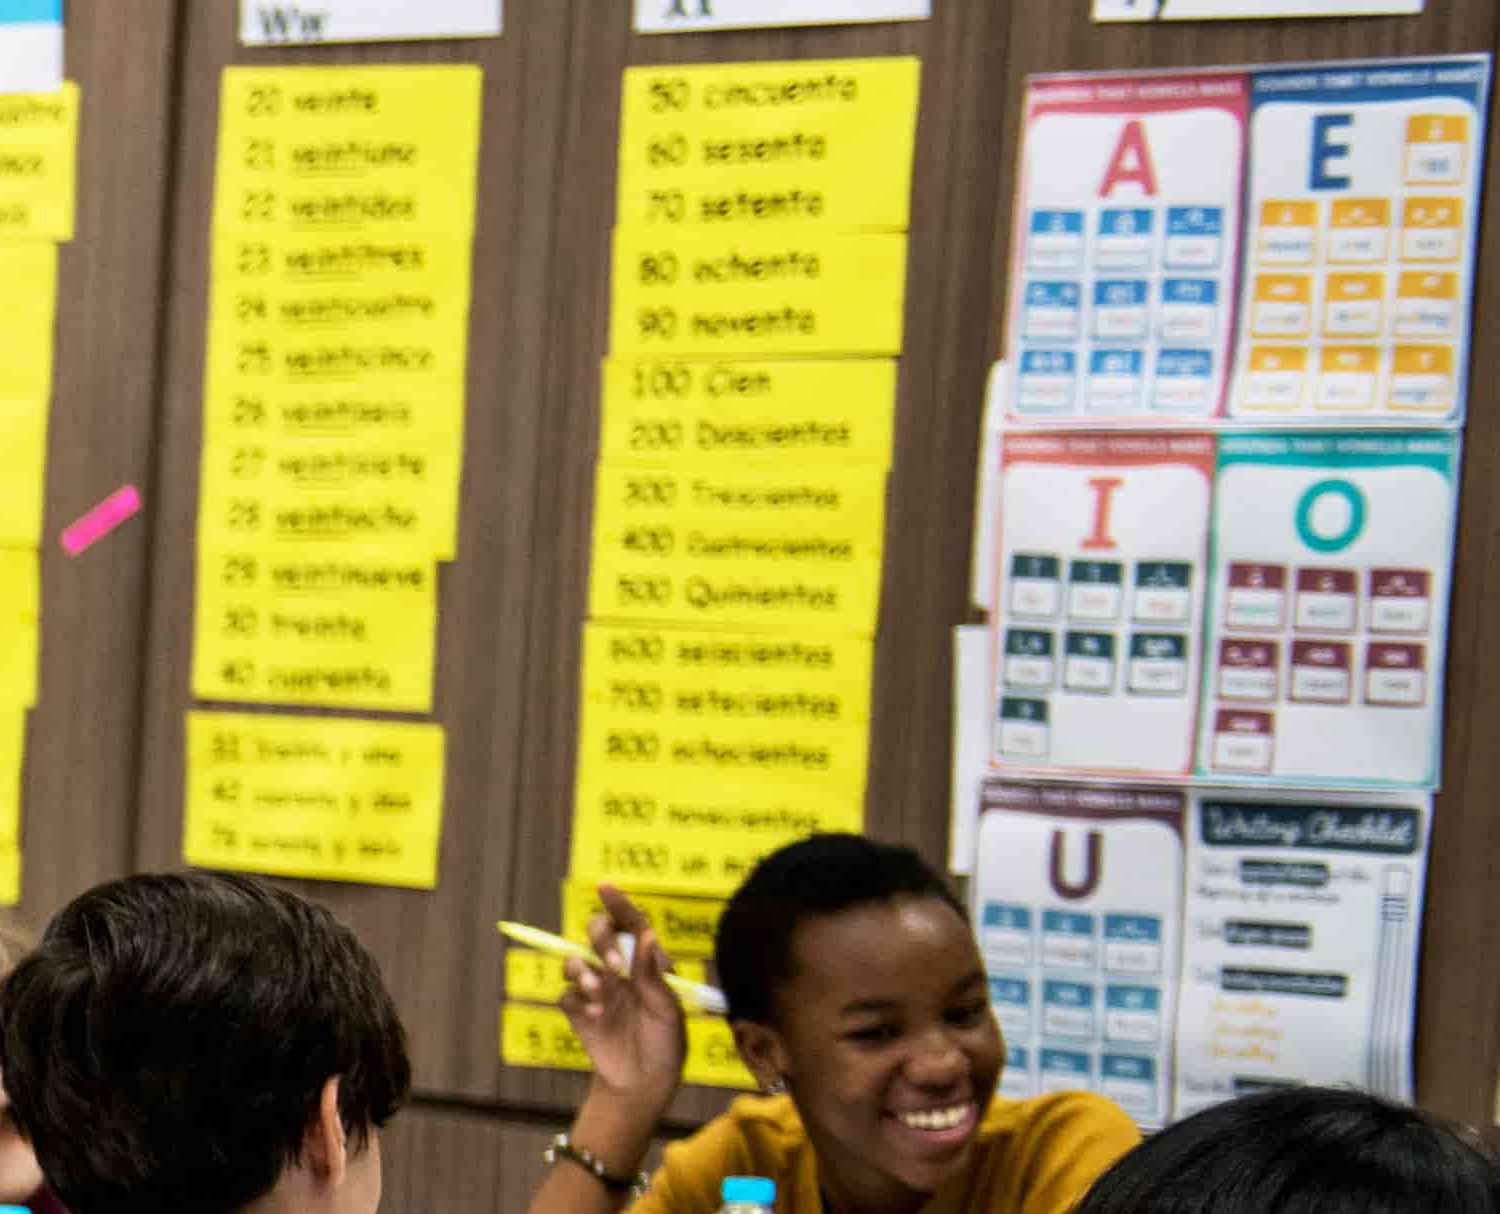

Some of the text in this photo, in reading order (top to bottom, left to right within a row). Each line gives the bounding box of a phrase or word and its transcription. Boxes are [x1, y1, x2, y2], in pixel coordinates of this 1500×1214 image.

[293, 89, 380, 114] veinte
[649, 75, 859, 112] 50 cincuenta
[647, 132, 826, 165] 60 sesenta
[1097, 119, 1158, 198] A
[1308, 112, 1355, 190] E
[647, 190, 825, 222] 70 setenta
[638, 251, 820, 285] 80 ochenta
[638, 307, 816, 340] 90 noventa
[632, 368, 771, 398] 100 Cien
[630, 421, 682, 450] 200
[624, 479, 840, 509] 300 Trescientos
[1081, 477, 1123, 549] I
[1294, 478, 1367, 553] O
[622, 526, 674, 553] 400
[618, 574, 839, 609] 500 Quinientos
[271, 612, 367, 639] treinta
[679, 641, 833, 669] seiscientos
[610, 681, 840, 717] 700 setecientos
[606, 732, 829, 769] 800 ochocientos
[1208, 808, 1414, 844] Writing Checklist
[1050, 829, 1104, 899] U
